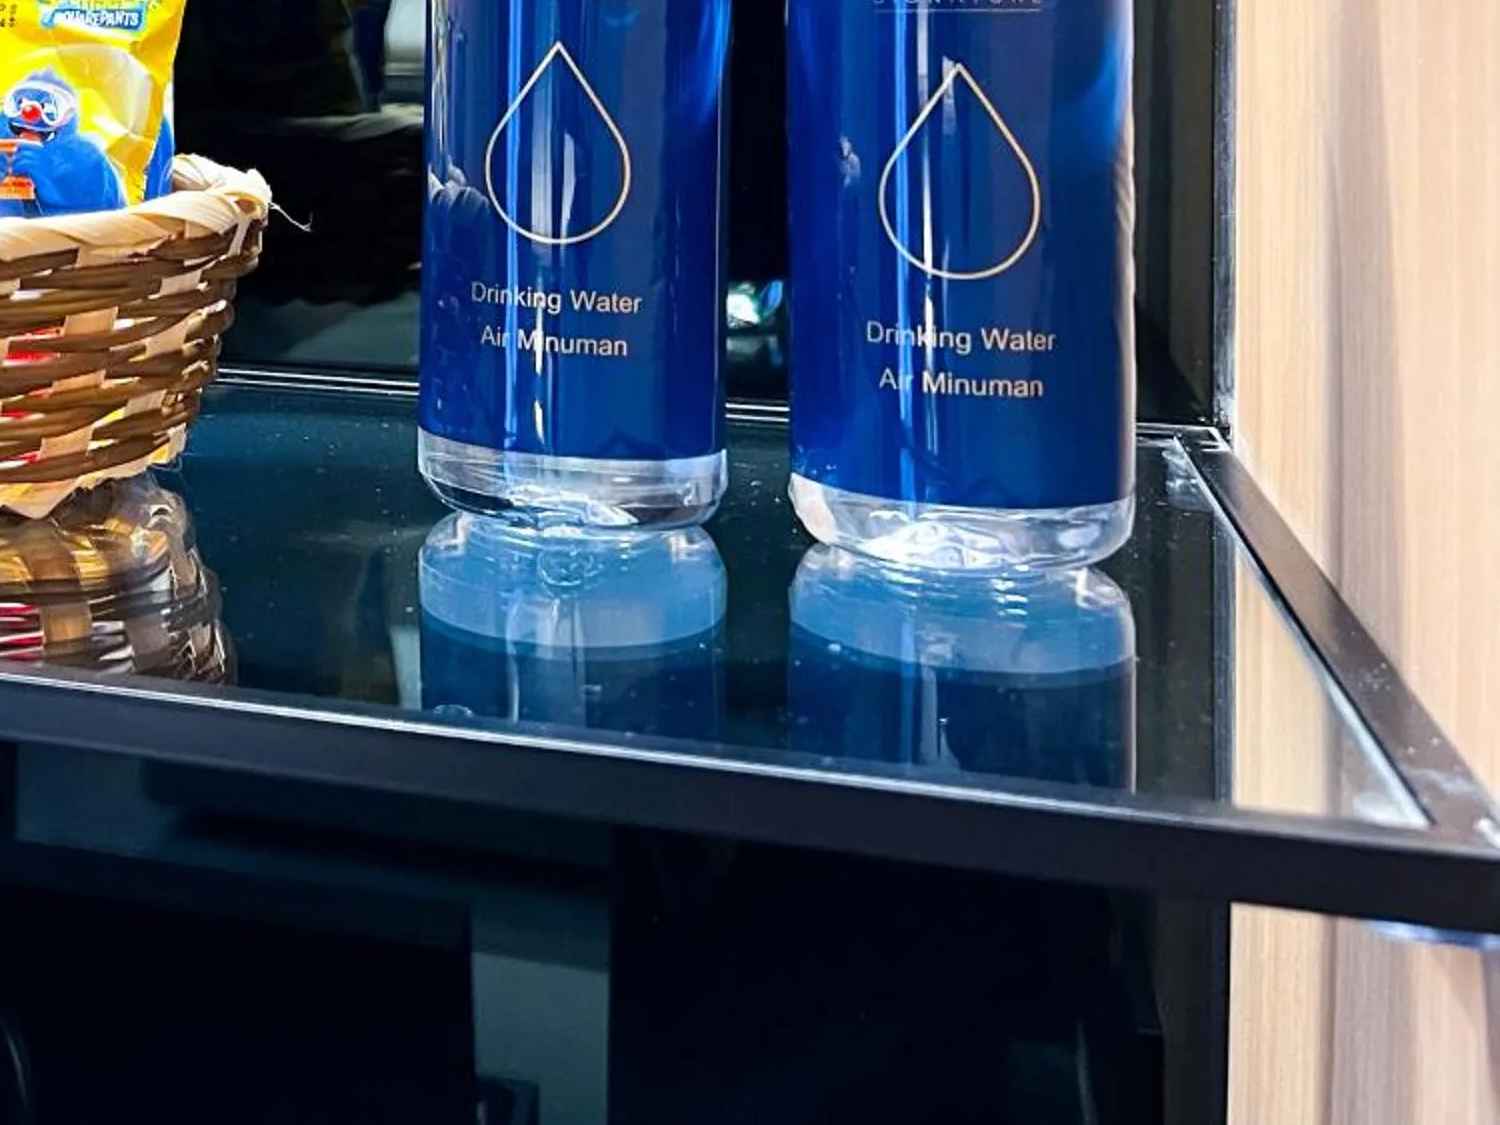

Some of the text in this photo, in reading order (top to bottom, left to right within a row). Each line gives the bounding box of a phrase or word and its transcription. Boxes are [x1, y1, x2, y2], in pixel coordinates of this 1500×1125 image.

[55, 9, 140, 27] QUAREPANTS
[471, 281, 643, 315] Drinking Water
[481, 325, 510, 348] Air
[867, 321, 1056, 355] Drinking Water
[879, 367, 1043, 397] Air Minuman
